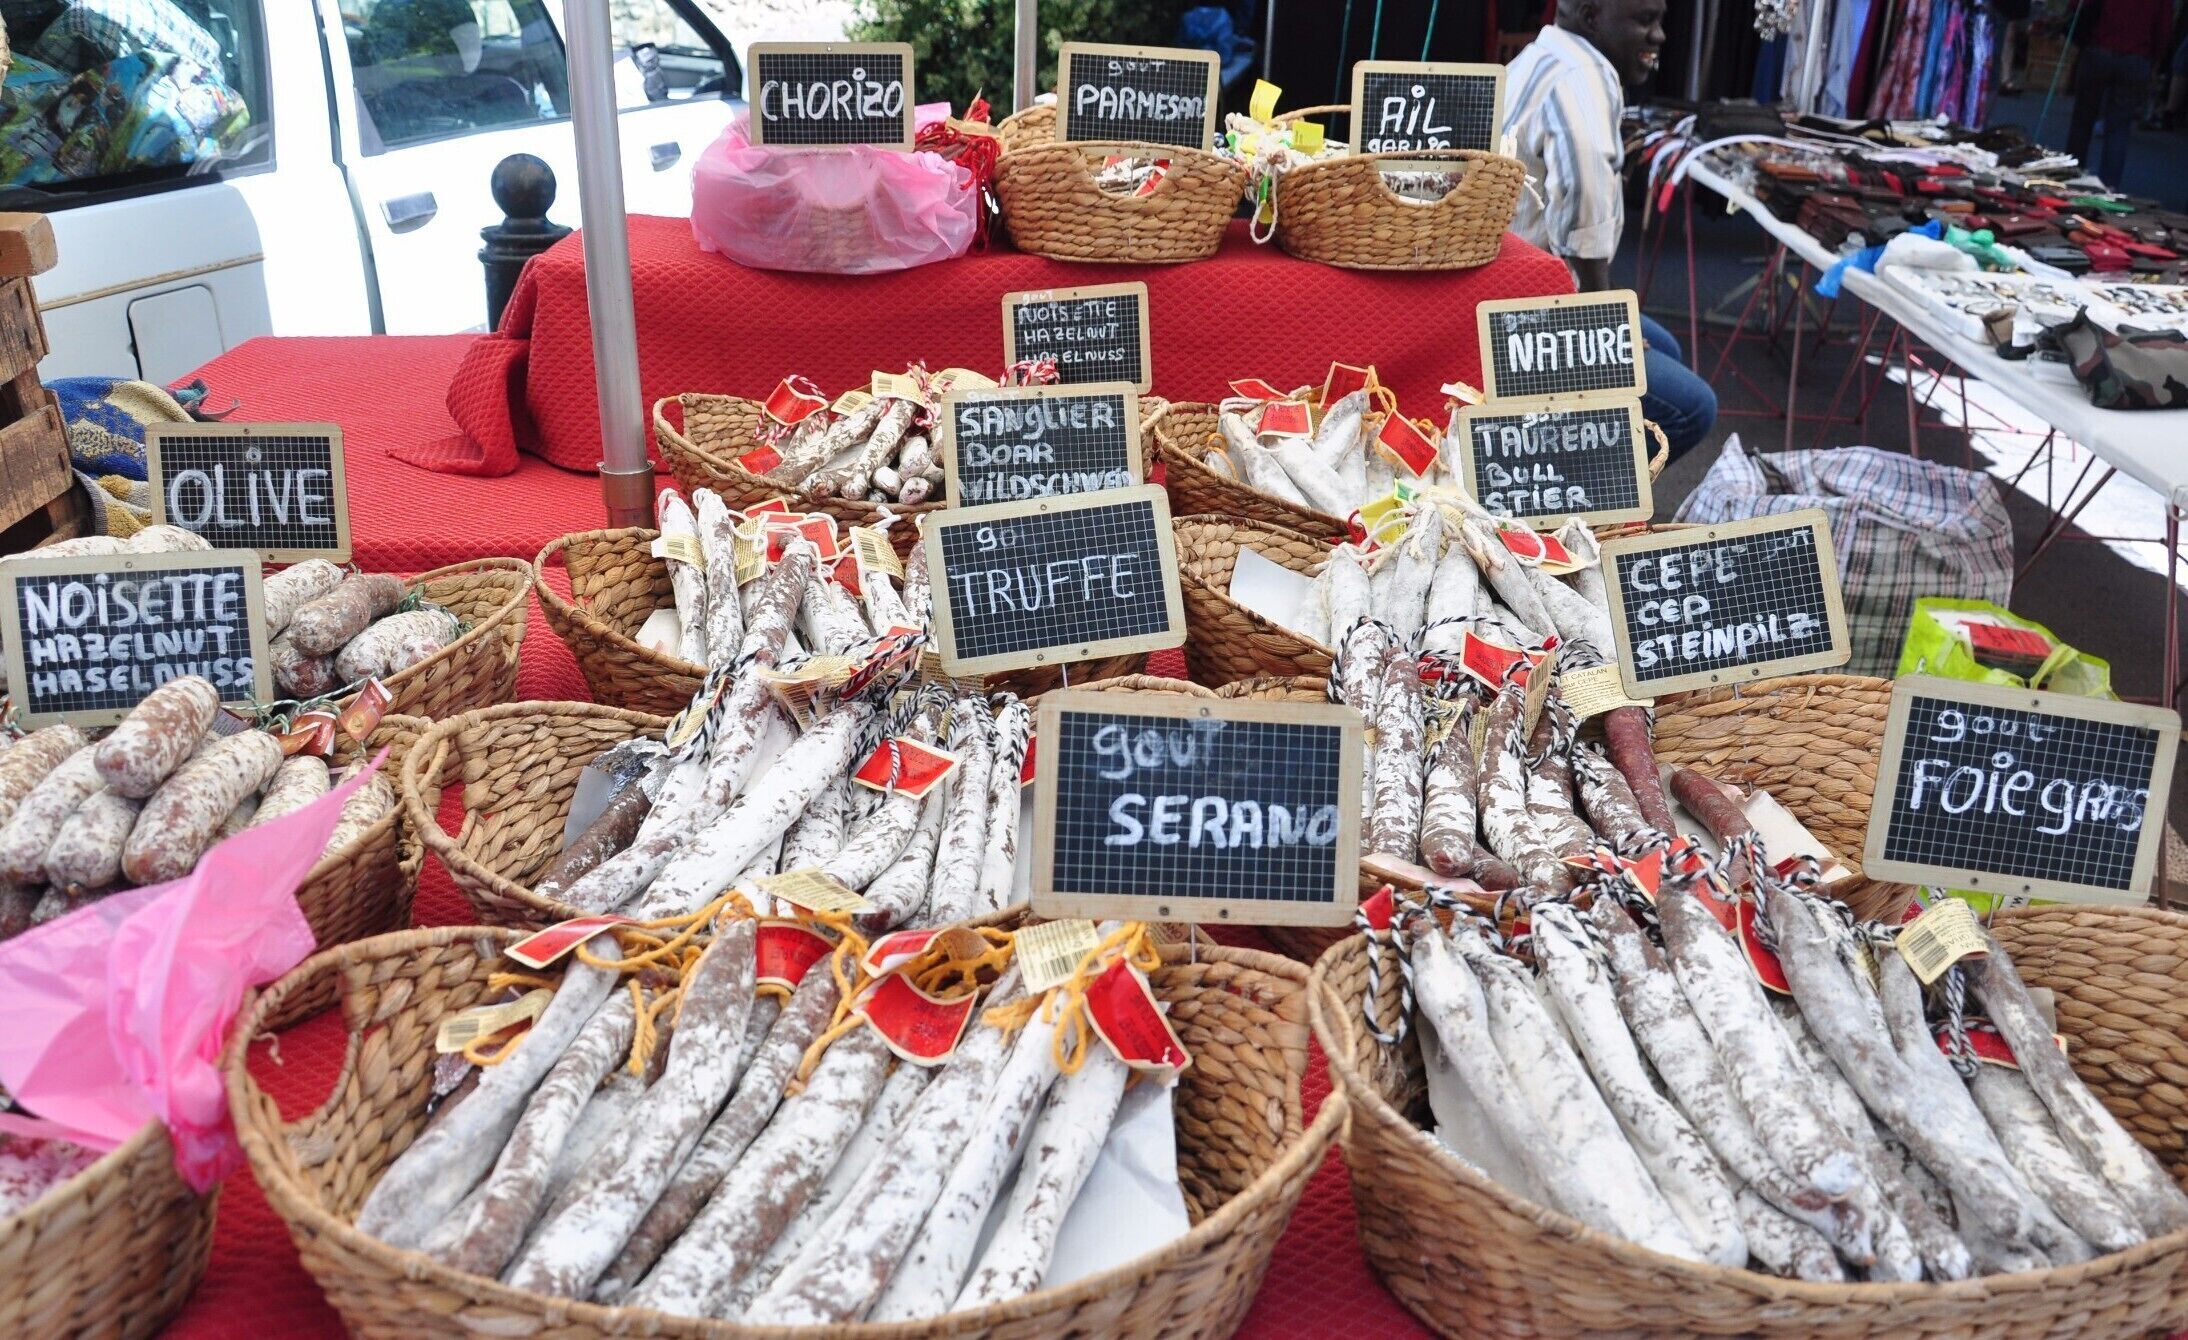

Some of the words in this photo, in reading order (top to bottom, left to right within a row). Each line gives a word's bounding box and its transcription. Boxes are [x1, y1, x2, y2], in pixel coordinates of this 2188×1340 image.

[1024, 322, 1119, 345] HAZELNUT
[1508, 324, 1634, 373] NATURE
[966, 442, 1054, 467] BOAR
[1475, 421, 1620, 458] TAUREAU
[1485, 462, 1564, 487] BULL
[949, 552, 1138, 617] TRUFFE
[1631, 543, 1748, 592] CEPE
[1637, 595, 1710, 625] CEP
[30, 625, 234, 667] HAZELNUT
[1104, 792, 1340, 849] SERANO
